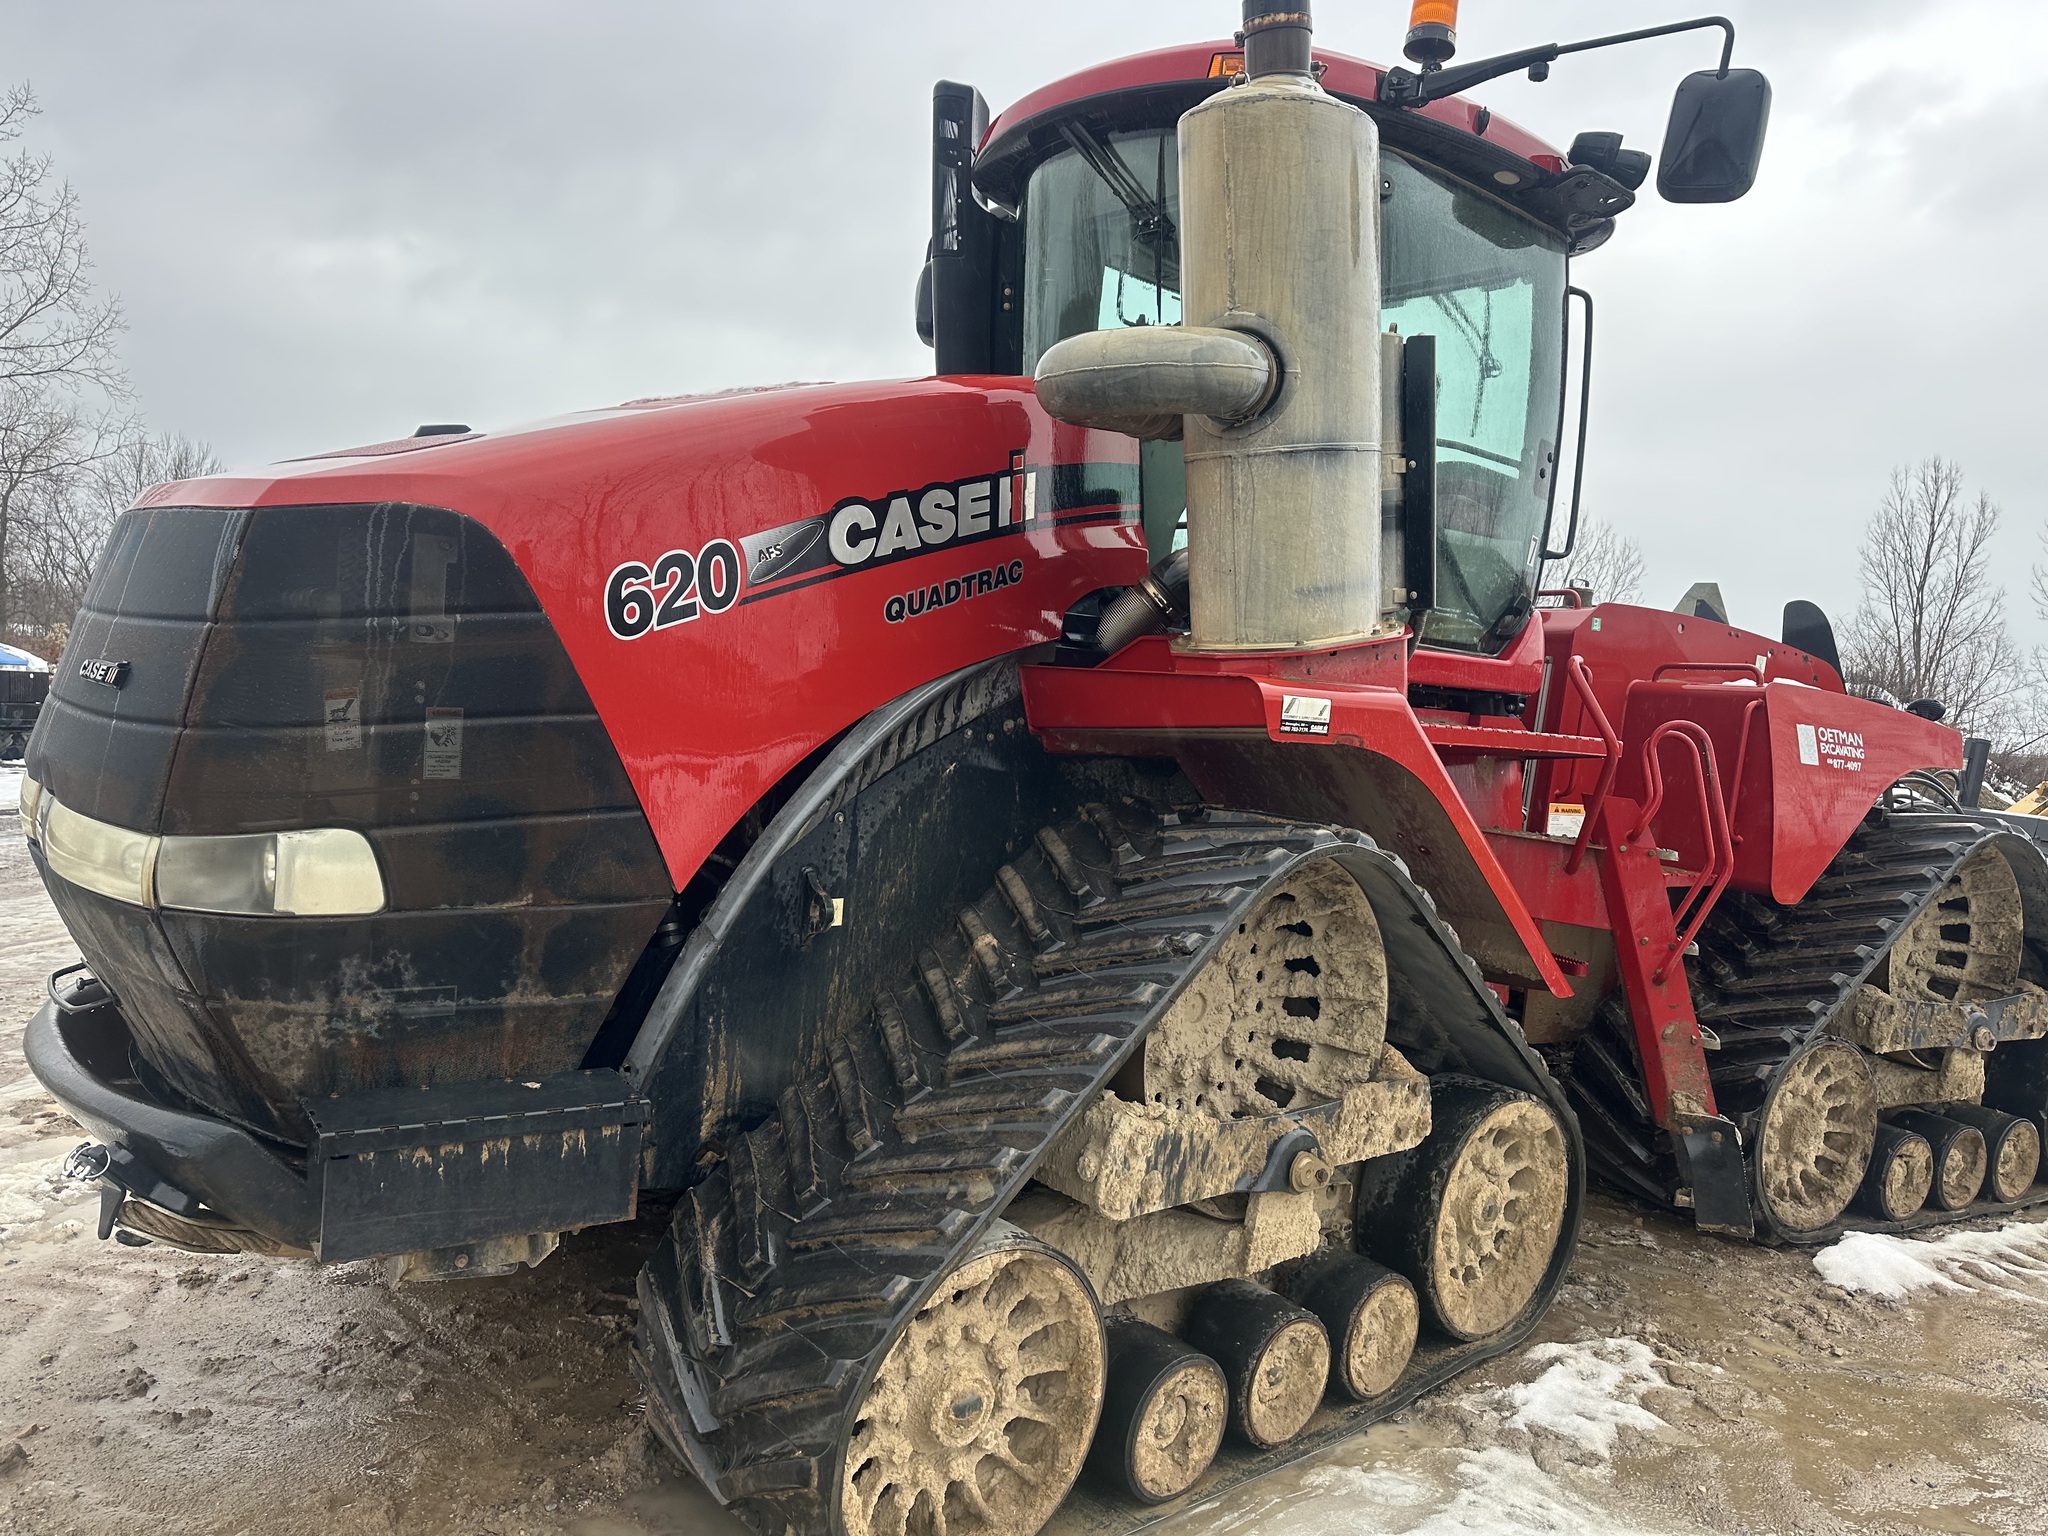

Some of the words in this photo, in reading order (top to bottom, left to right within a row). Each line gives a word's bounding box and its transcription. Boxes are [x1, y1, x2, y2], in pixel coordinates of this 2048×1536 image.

[828, 479, 991, 565] CASE
[757, 543, 785, 563] AFS
[604, 537, 741, 642] 620
[884, 560, 1025, 624] QUADTRAC
[80, 659, 107, 680] CASE
[1818, 727, 1863, 747] OETMAN
[1820, 742, 1865, 759] EXCAVATING
